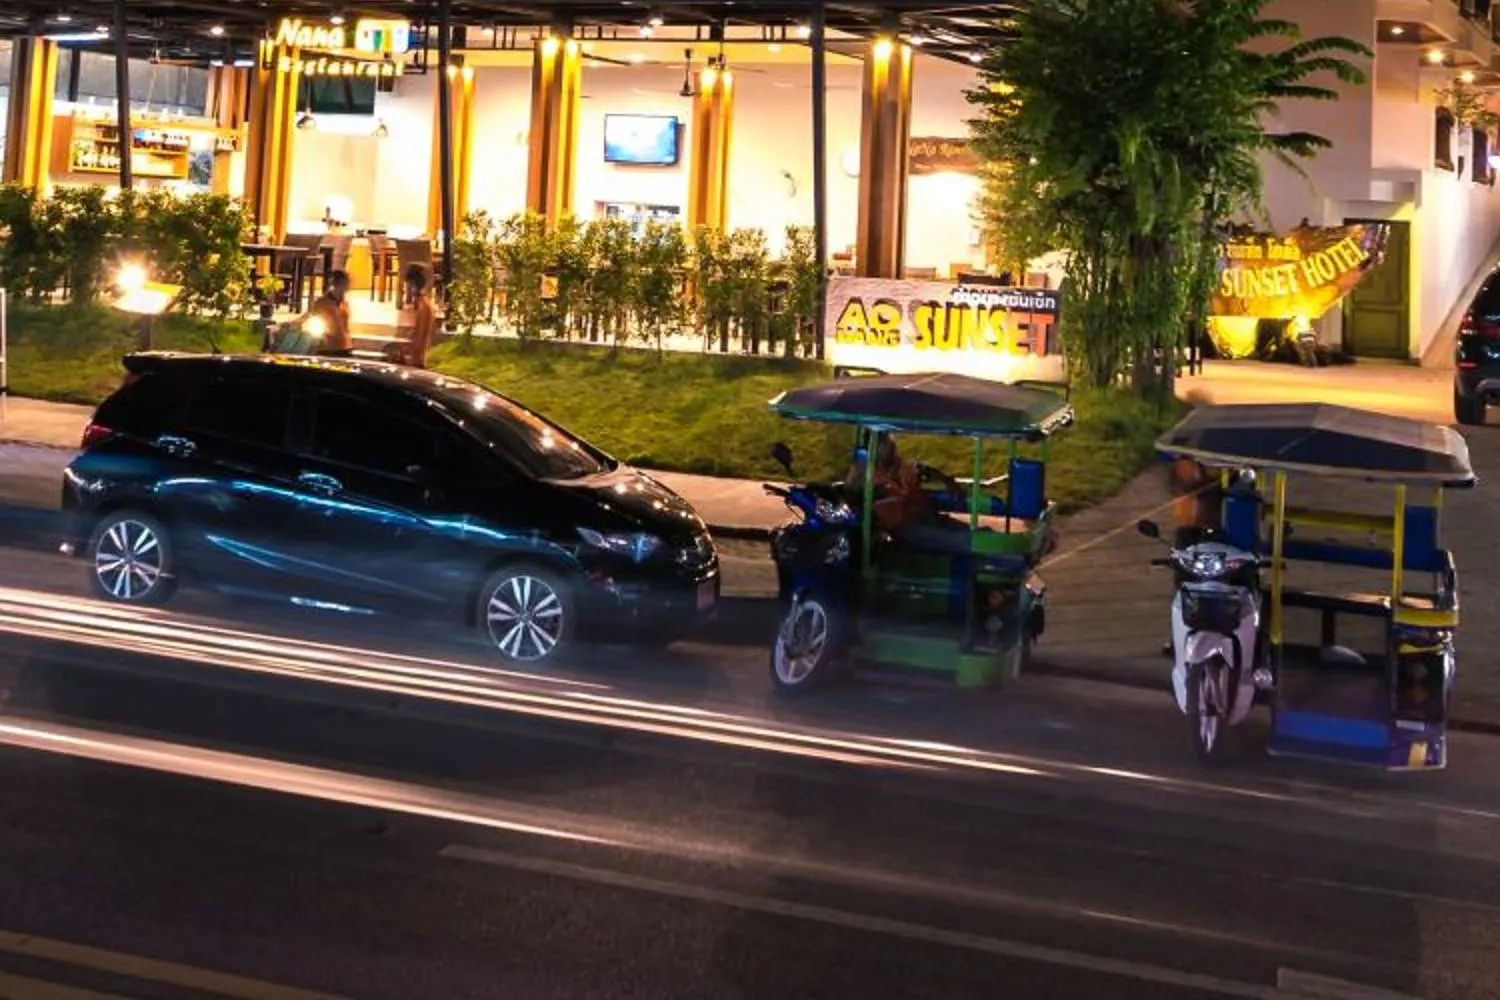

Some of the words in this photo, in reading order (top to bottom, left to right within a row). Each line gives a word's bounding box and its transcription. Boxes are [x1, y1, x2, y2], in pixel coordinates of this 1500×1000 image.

[1221, 264, 1301, 298] SUNSET
[1301, 236, 1370, 288] HOTEL
[914, 303, 1055, 357] SUNSET
